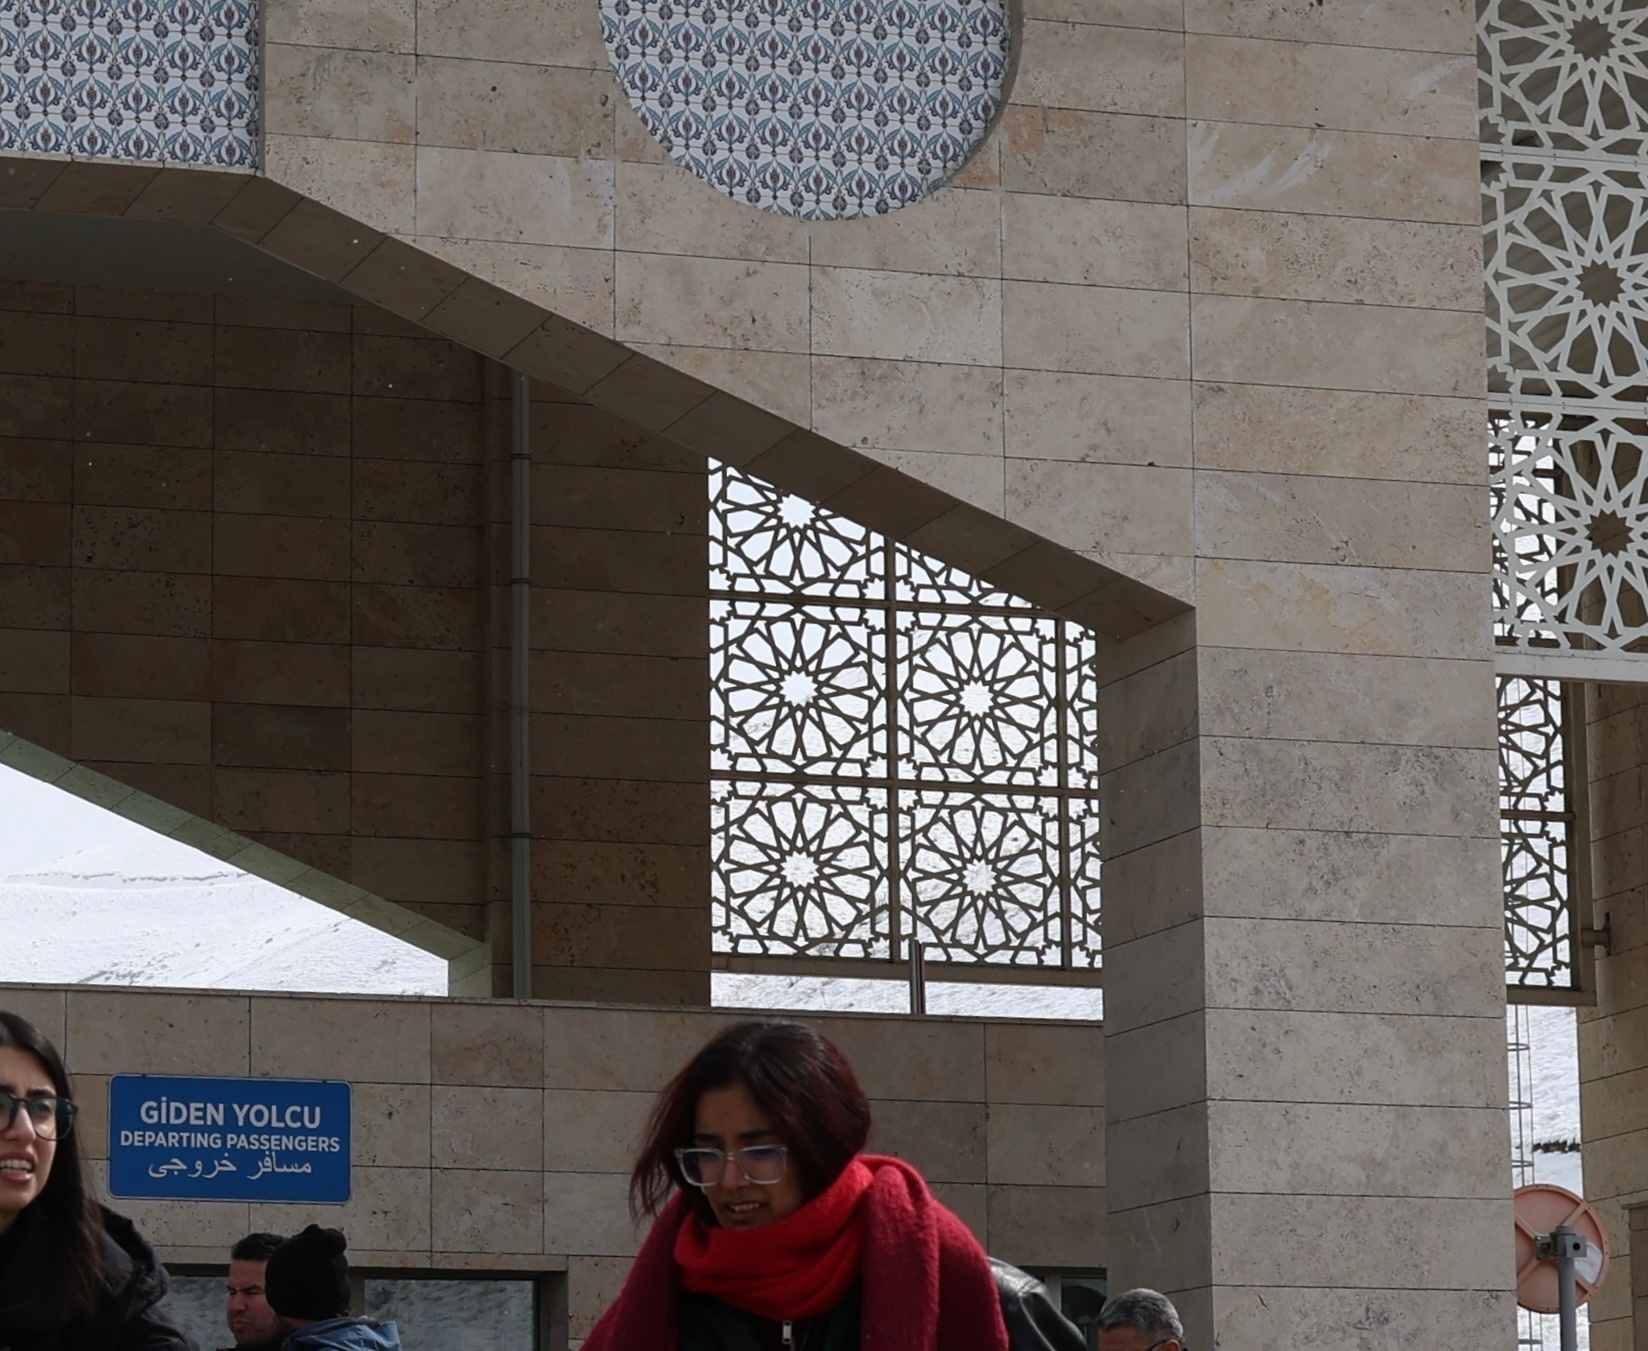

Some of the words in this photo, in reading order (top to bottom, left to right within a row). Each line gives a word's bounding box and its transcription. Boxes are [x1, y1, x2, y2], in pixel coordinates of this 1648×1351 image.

[140, 1097, 224, 1126] GİDEN
[232, 1103, 321, 1129] YOLCU
[120, 1130, 222, 1149] DEPARTING
[226, 1134, 340, 1152] PASSENGERS
[246, 1150, 312, 1180] مسافر
